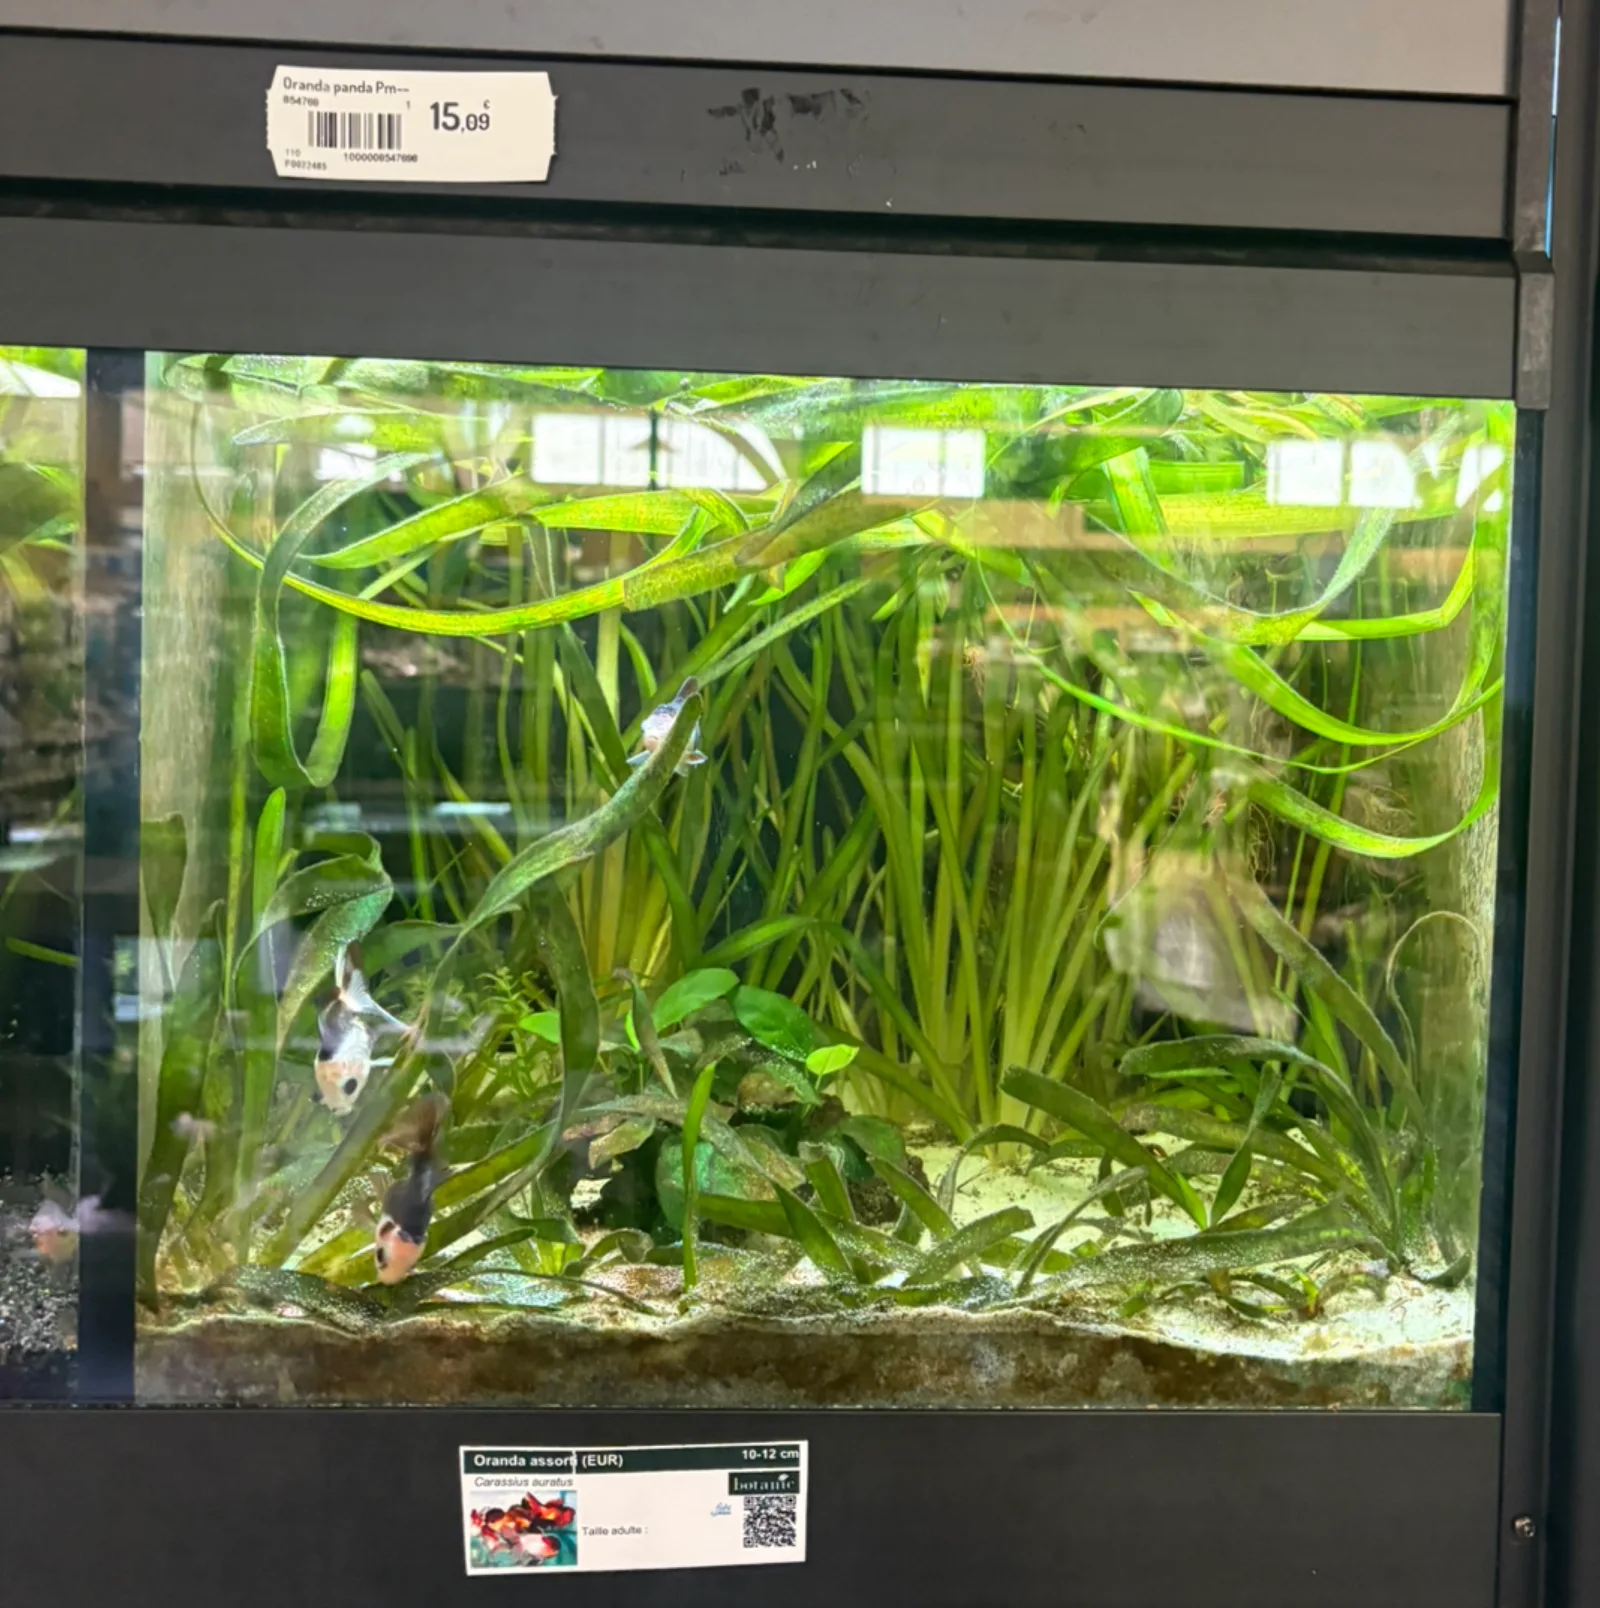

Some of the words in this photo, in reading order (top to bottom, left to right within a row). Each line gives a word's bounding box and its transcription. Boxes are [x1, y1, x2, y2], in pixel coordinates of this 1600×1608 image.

[283, 76, 331, 92] Oranda
[333, 80, 373, 96] panda
[429, 101, 490, 134] 15,09
[742, 1448, 777, 1460] 10-12
[780, 1450, 800, 1459] cm
[473, 1454, 526, 1467] Oranda
[581, 1454, 624, 1468] (EUR)
[474, 1477, 529, 1488] Carassius
[531, 1477, 574, 1487] auratus
[611, 1525, 642, 1535] adulte
